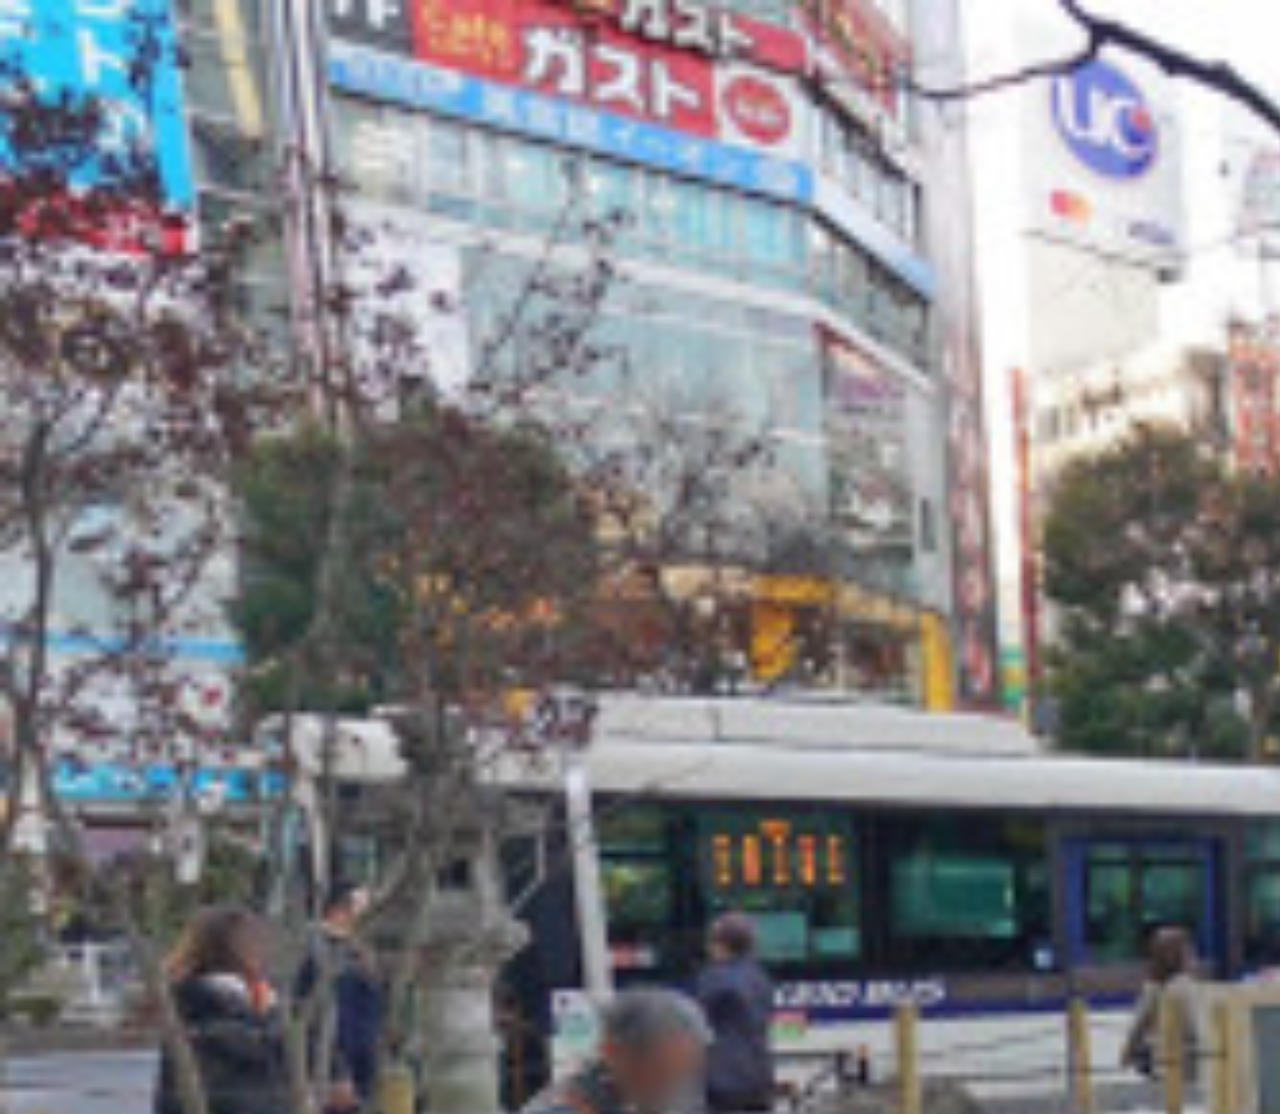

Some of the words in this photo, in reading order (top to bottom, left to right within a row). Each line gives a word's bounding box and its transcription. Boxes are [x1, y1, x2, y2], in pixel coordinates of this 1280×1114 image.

[522, 24, 702, 118] ガスト
[1059, 76, 1156, 158] UC
